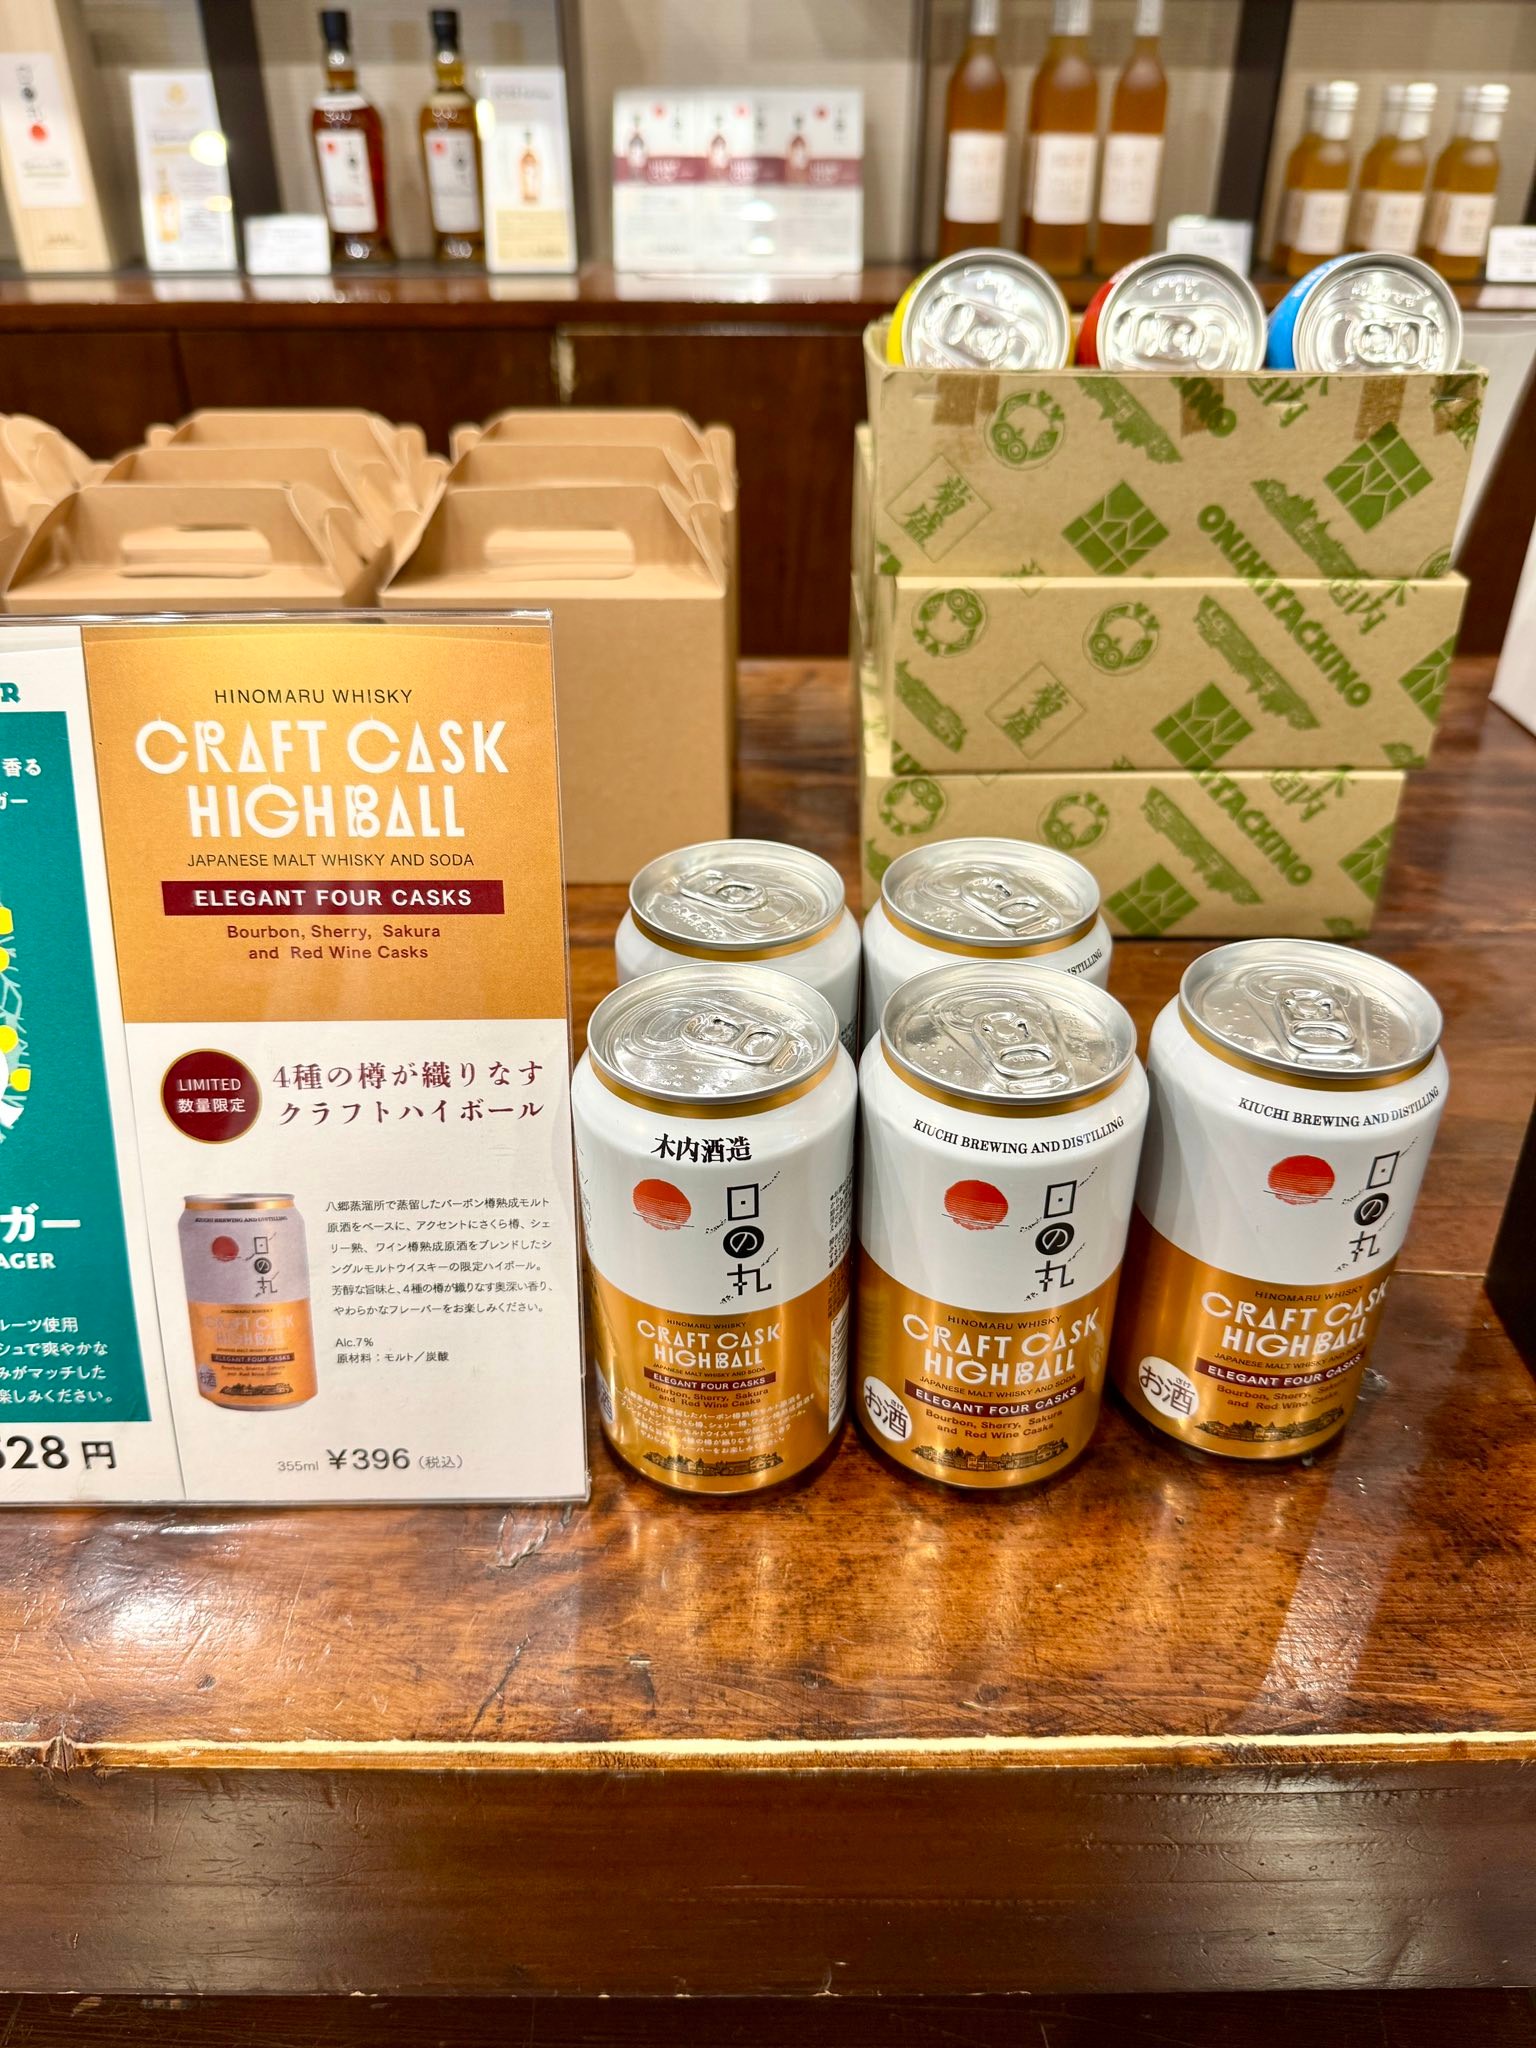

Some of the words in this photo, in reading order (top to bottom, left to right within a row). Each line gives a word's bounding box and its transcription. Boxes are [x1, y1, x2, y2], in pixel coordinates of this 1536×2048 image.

[214, 689, 325, 704] HINOMARU
[332, 689, 413, 704] WHISKY
[135, 716, 327, 775] CRAFT
[346, 716, 509, 775] CASK
[187, 780, 466, 839] HIGHBALL
[186, 853, 269, 868] JAPANESE
[273, 853, 317, 868] MALT
[321, 853, 385, 868] WHISKY
[389, 853, 425, 868] AND
[429, 853, 475, 868] SODA
[194, 888, 307, 907] ELEGANT
[315, 888, 383, 907] FOUR
[391, 888, 472, 907] CASKS
[227, 925, 306, 941] Bourbon,
[310, 925, 372, 942] Sherry,
[382, 924, 441, 939] Sakura
[248, 945, 279, 960] and
[290, 945, 325, 960] Red
[328, 945, 373, 960] Wine
[377, 945, 429, 960] Casks
[178, 1077, 241, 1093] LIMITED
[272, 1061, 543, 1091] 4種の樽が織りなす
[177, 1097, 247, 1114] 数量限定
[279, 1099, 544, 1126] クラフトハイボール
[1238, 1097, 1289, 1121] KIUCHI
[1292, 1112, 1360, 1127] BREWING
[1362, 1113, 1389, 1127] AND
[1391, 1086, 1440, 1121] DISTILLING
[913, 1118, 958, 1145] KIUCHI
[960, 1135, 1028, 1155] BREWING
[1030, 1140, 1061, 1154] AND
[1062, 1115, 1125, 1151] DISTILLING
[650, 1133, 752, 1163] 木内酒造
[1201, 1291, 1318, 1331] CRAFT
[1323, 1276, 1391, 1326] CASK
[1255, 1290, 1321, 1302] HINOMARU
[1324, 1285, 1363, 1301] WHISKY
[333, 1302, 543, 1316] やわらかなフレーバーをお楽しみください。
[666, 1319, 711, 1330] HINOMARU
[713, 1321, 747, 1330] WHISKY
[903, 1314, 1012, 1359] CRAFT
[1021, 1307, 1099, 1357] CASK
[947, 1315, 1013, 1330] HINOMARU
[1017, 1315, 1063, 1330] WHISKY
[334, 1338, 374, 1348] Alc.7%
[637, 1320, 710, 1349] CRAFT
[717, 1322, 782, 1350] CASK
[1220, 1317, 1368, 1357] HIGHBALL
[654, 1343, 763, 1369] HIGHBALL
[924, 1348, 1076, 1386] HIGHBALL
[1215, 1352, 1262, 1368] JAPANESE
[1265, 1362, 1290, 1370] MALT
[653, 1363, 682, 1375] JAPANESE
[1207, 1364, 1280, 1386] ELEGANT
[1283, 1373, 1323, 1386] FOUR
[648, 1381, 691, 1399] Bourbon,
[693, 1393, 729, 1402] Sherry,
[735, 1388, 769, 1399] Sakura
[653, 1372, 698, 1389] ELEGANT
[700, 1382, 729, 1391] FOUR
[732, 1376, 766, 1390] CASKS
[919, 1376, 965, 1395] JAPANESE
[996, 1389, 1033, 1398] WHISKY
[1035, 1384, 1053, 1394] AND
[1140, 1365, 1196, 1415] お酒
[1216, 1384, 1269, 1401] Bourbon,
[658, 1394, 676, 1403] and
[681, 1399, 701, 1408] Red
[703, 1401, 729, 1409] Wine
[731, 1398, 761, 1408] Casks
[915, 1388, 983, 1414] ELEGANT
[989, 1403, 1030, 1415] FOUR
[1035, 1386, 1077, 1410] CASKS
[1227, 1398, 1249, 1409] and
[1256, 1402, 1278, 1410] Red
[1282, 1401, 1308, 1410] Wine
[866, 1385, 909, 1439] お酒
[926, 1409, 977, 1429] Bourbon,
[981, 1421, 1021, 1431] Sherry,
[1028, 1409, 1063, 1426] Sakura
[937, 1424, 958, 1436] and
[965, 1430, 987, 1439] Red
[991, 1431, 1019, 1439] Wine
[1023, 1423, 1054, 1437] Casks
[81, 1440, 117, 1470] 円
[278, 1460, 319, 1472] 355ml
[326, 1447, 411, 1471] ¥396
